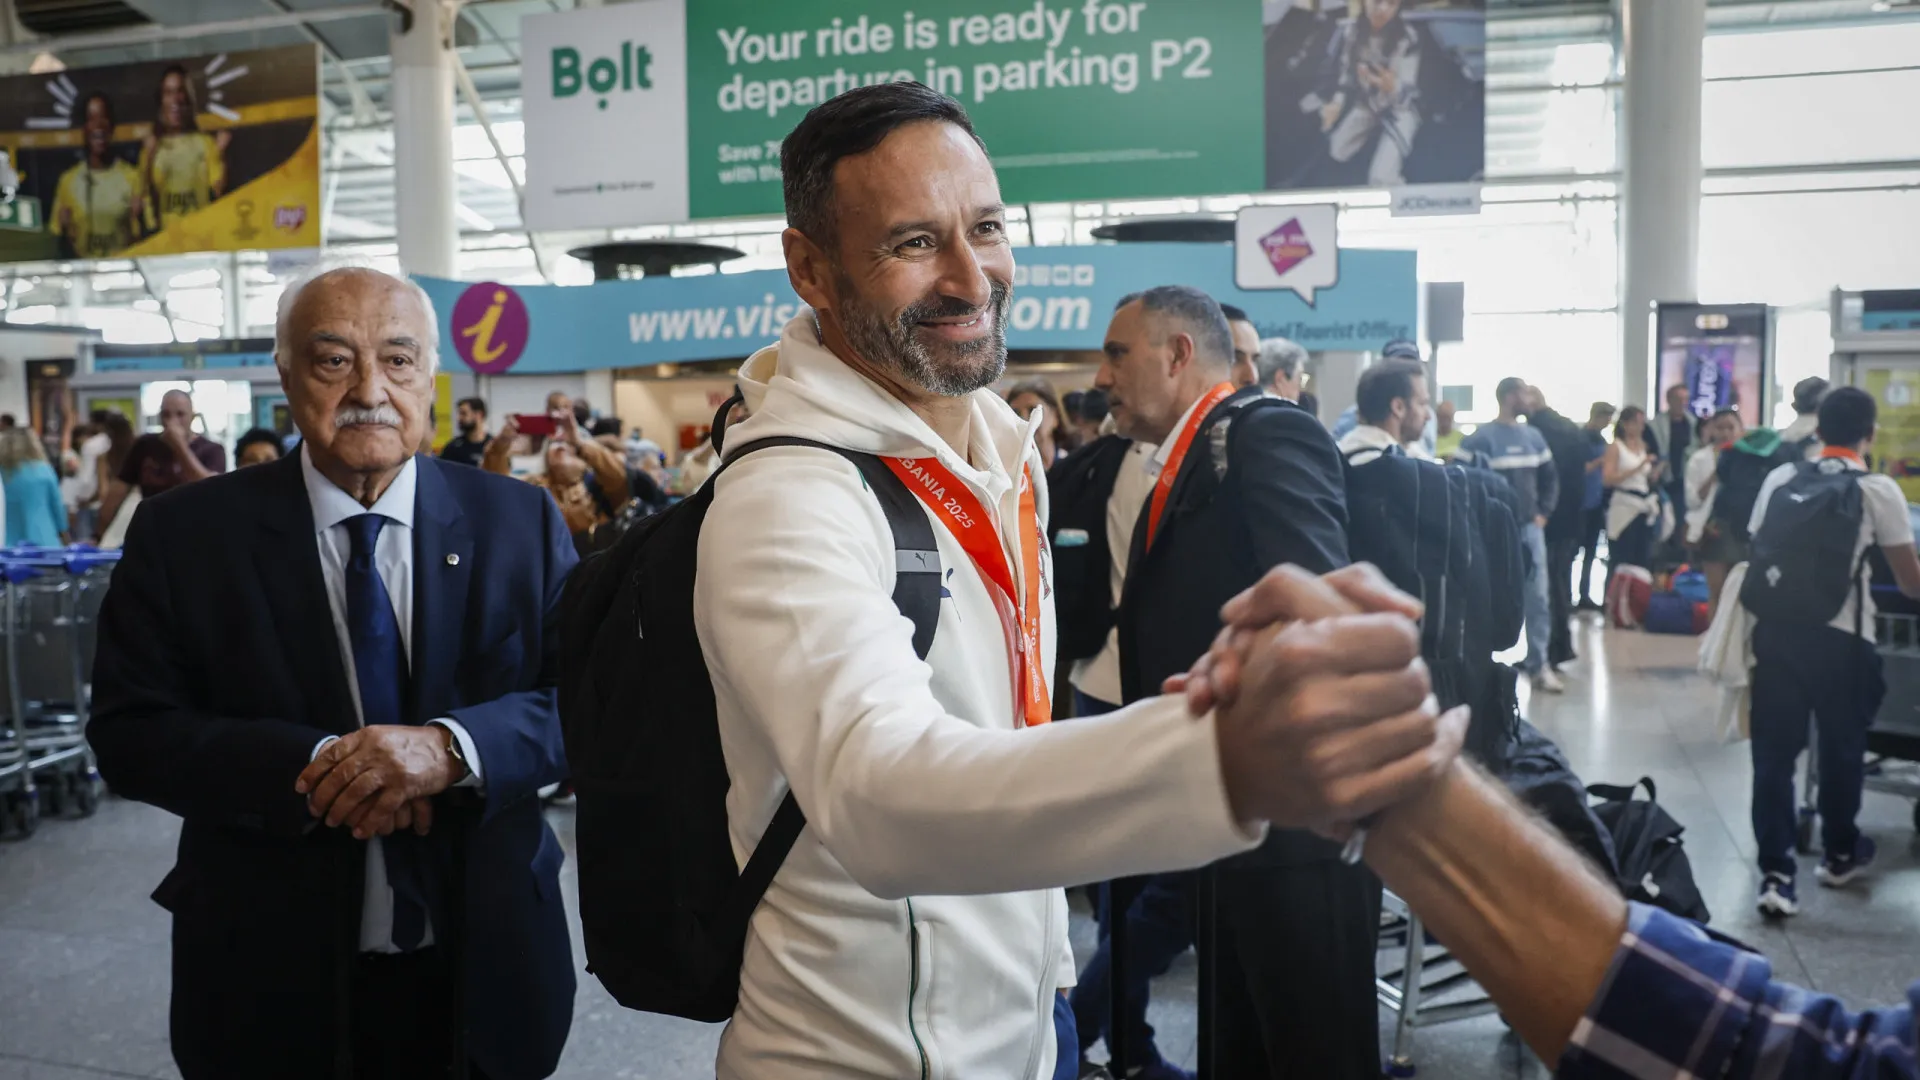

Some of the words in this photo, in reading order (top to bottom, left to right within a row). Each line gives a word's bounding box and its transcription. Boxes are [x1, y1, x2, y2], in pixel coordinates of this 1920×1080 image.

[717, 26, 807, 66] Your
[816, 15, 894, 57] ride
[903, 11, 938, 50] is
[949, 1, 1072, 48] ready
[1081, 0, 1147, 36] for
[551, 40, 653, 110] Bolt
[925, 58, 963, 95] in
[974, 46, 1139, 103] parking
[1151, 37, 1212, 81] P2
[718, 144, 762, 163] Save
[718, 166, 757, 184] with
[628, 292, 795, 343] www.vis
[1010, 297, 1092, 330] om
[944, 498, 976, 529] 2025
